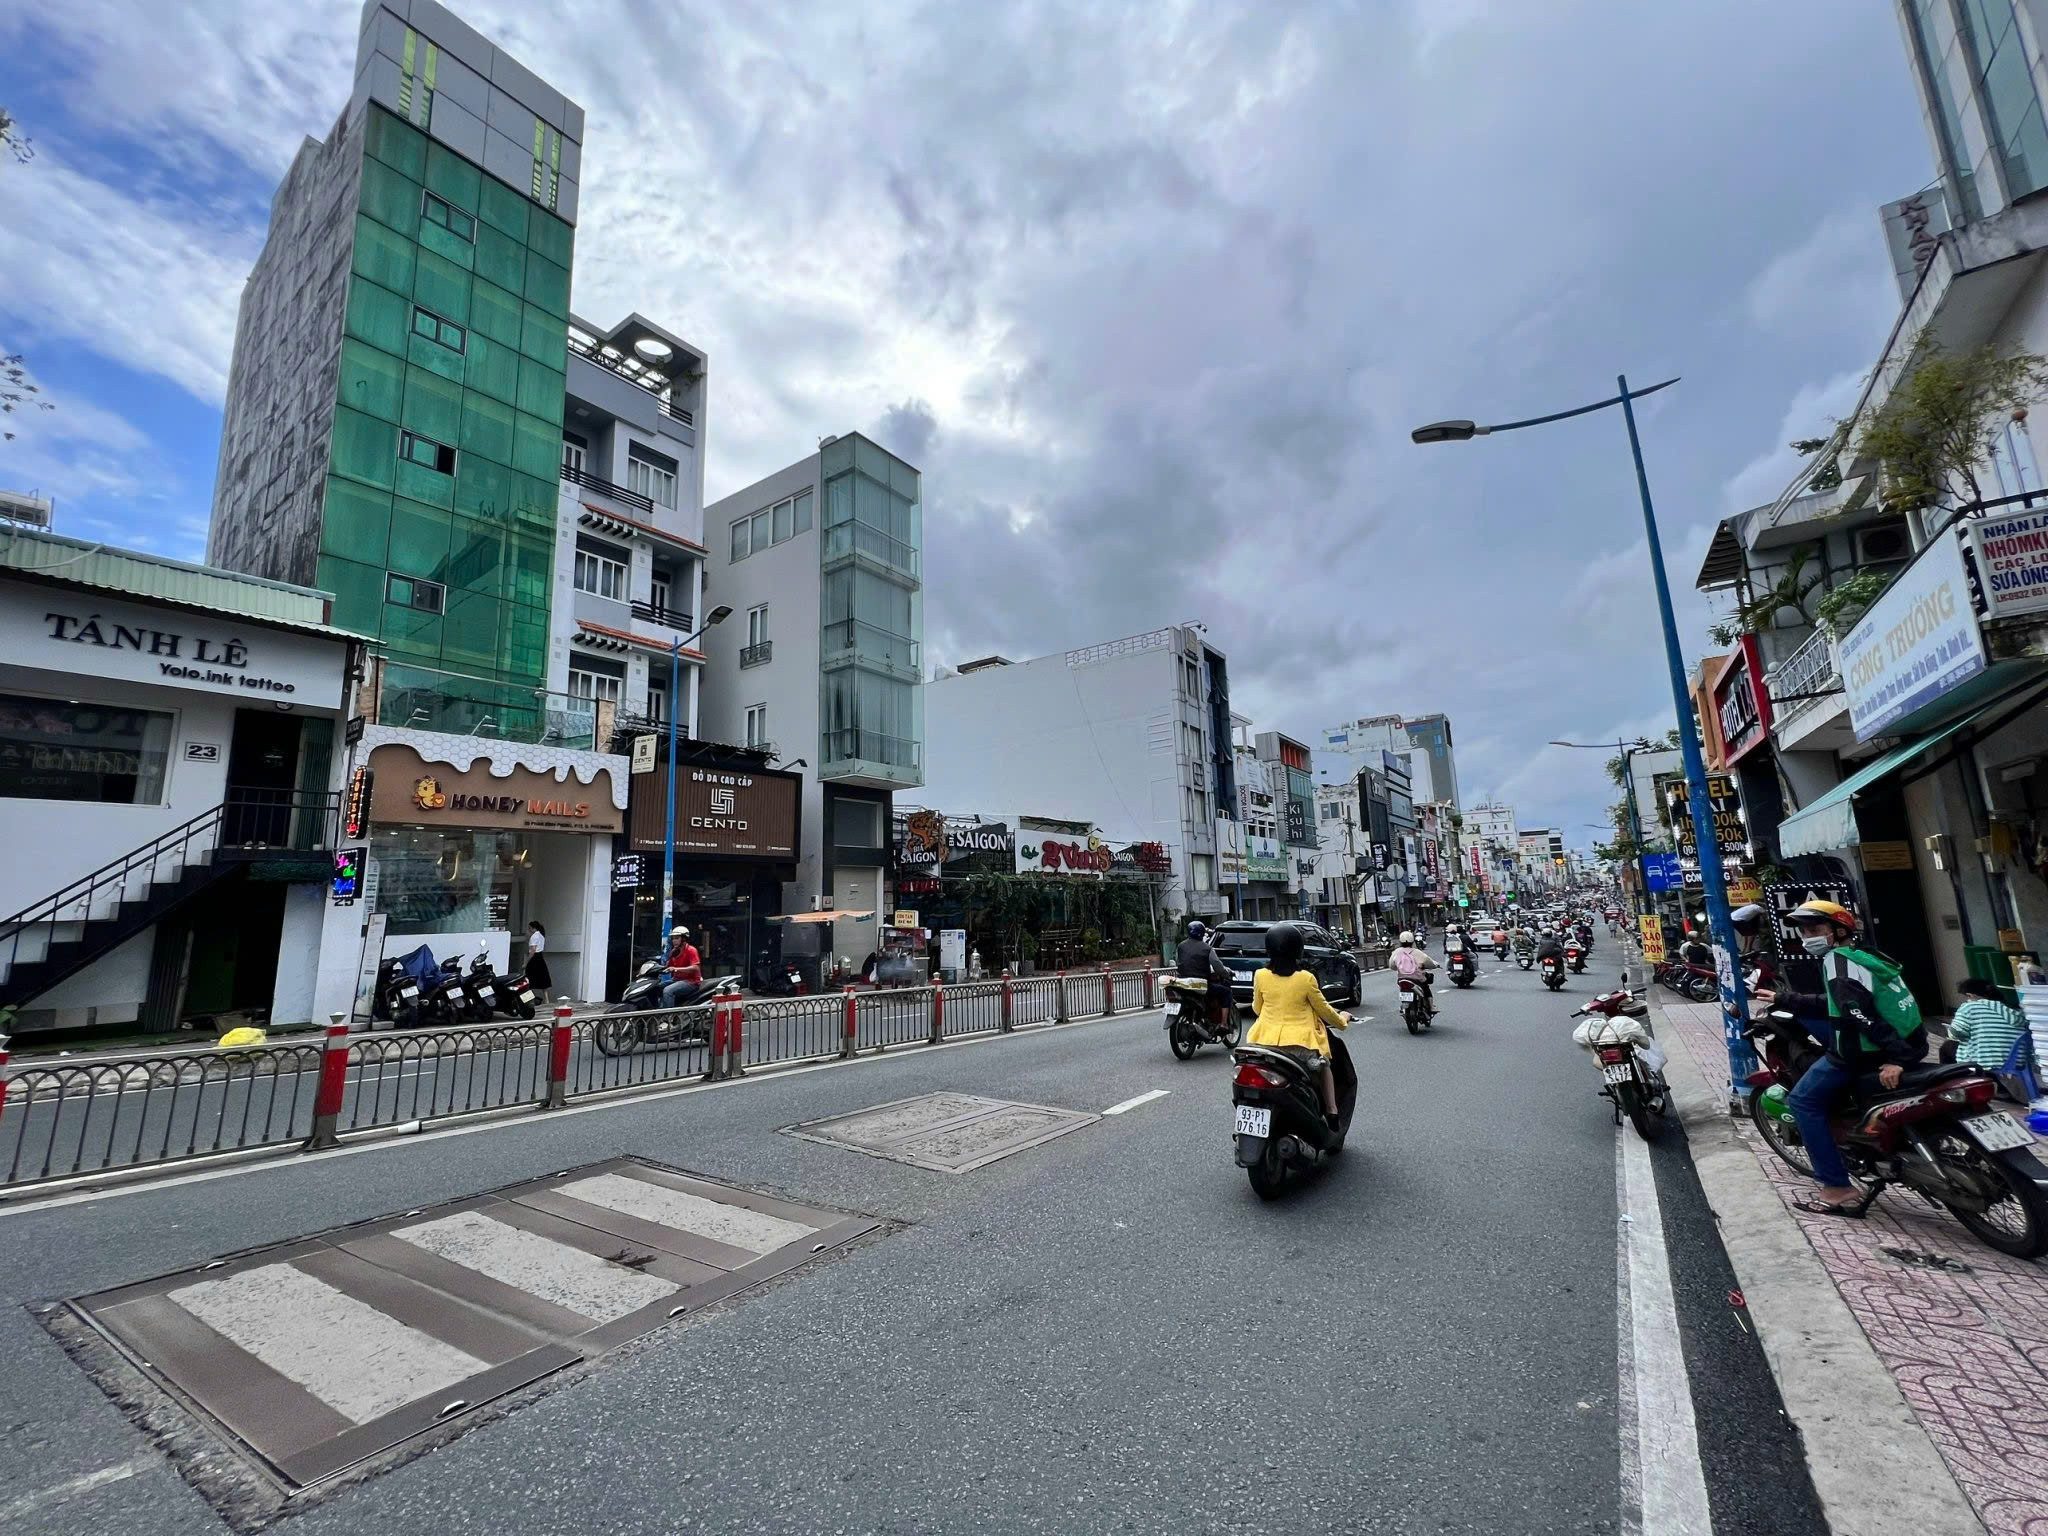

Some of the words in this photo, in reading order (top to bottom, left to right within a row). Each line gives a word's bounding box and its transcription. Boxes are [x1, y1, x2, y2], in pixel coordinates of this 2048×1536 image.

[193, 637, 248, 668] LÊ
[160, 662, 233, 685] Yolo.ink
[239, 674, 295, 694] tattoo
[188, 744, 217, 758] 23
[706, 773, 718, 783] DA
[720, 775, 735, 785] CAO
[1671, 779, 1733, 800] HEL
[451, 793, 524, 813] HONEY
[527, 799, 590, 818] NAILS
[1289, 804, 1301, 815] Ki
[1289, 817, 1303, 826] su
[956, 830, 1007, 851] SAIGON
[1291, 828, 1303, 839] hi
[900, 851, 937, 864] SAIGON
[1241, 1108, 1265, 1122] 93-P1
